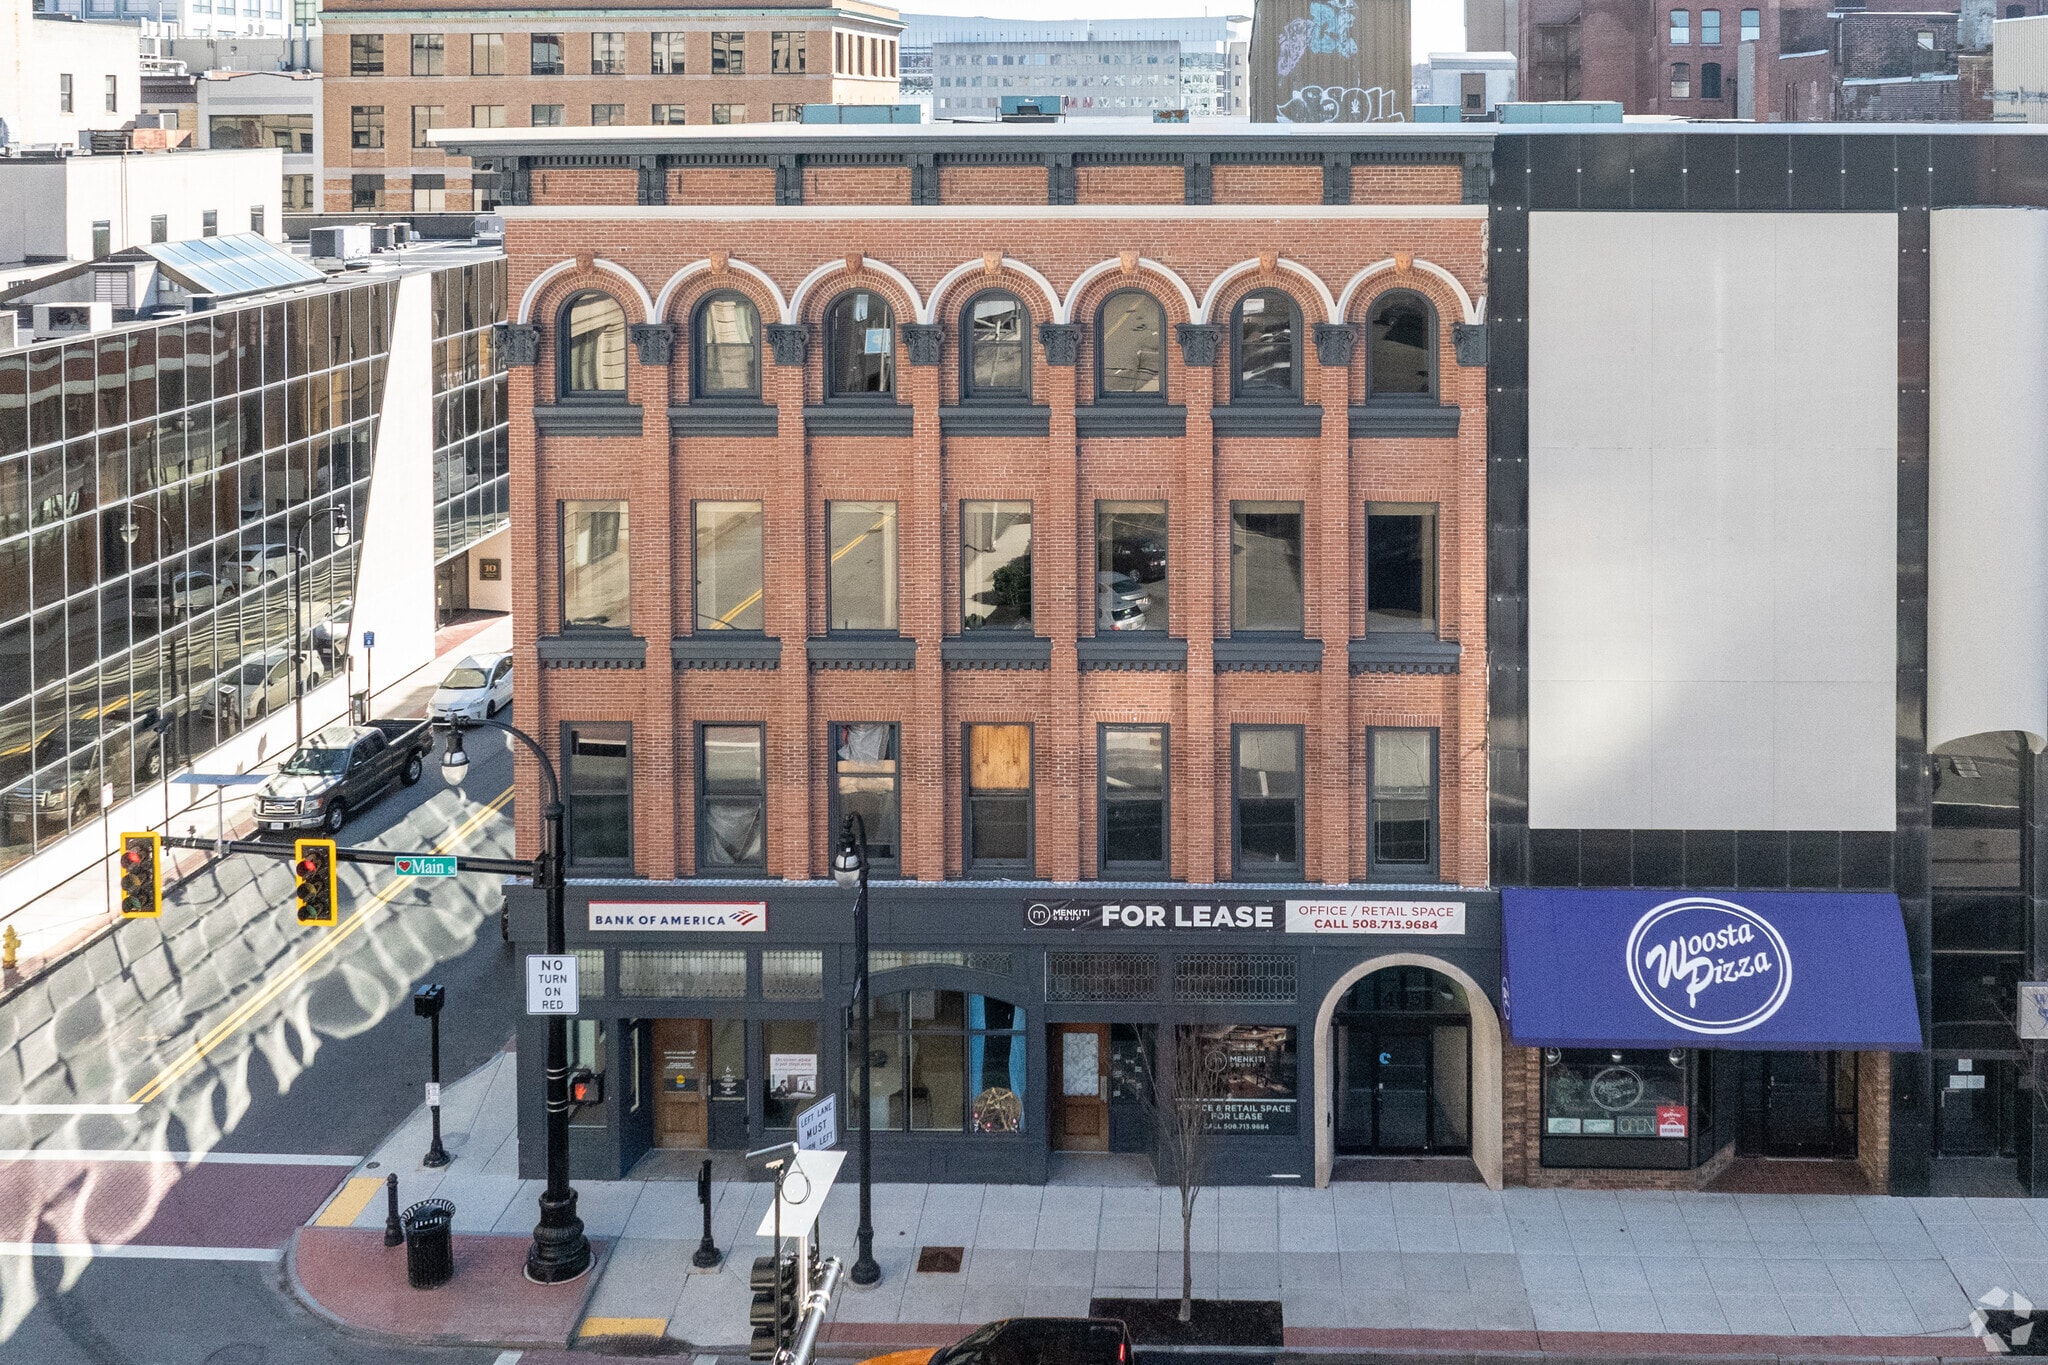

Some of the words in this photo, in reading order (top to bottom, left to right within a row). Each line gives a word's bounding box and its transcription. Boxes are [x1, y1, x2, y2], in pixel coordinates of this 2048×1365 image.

[412, 859, 444, 873] Main
[1053, 909, 1090, 917] MENKITI
[1102, 905, 1166, 927] FOR
[1175, 906, 1273, 928] LEASE
[1298, 906, 1347, 916] OFFICE
[1361, 907, 1407, 916] RETAIL
[1411, 908, 1454, 917] SPACE
[595, 915, 634, 925] BANK
[638, 915, 656, 925] OF
[660, 915, 726, 925] AMERICA
[1314, 919, 1348, 929] CALL
[1352, 920, 1438, 930] 508.713.9684
[1645, 923, 1755, 989] Woosta
[541, 960, 563, 971] NO
[538, 974, 567, 984] TURN
[1686, 952, 1773, 1009] Pizza
[544, 987, 561, 997] ON
[542, 1000, 564, 1010] RED
[1225, 1104, 1258, 1112] RETAIL
[801, 1113, 813, 1128] LEFT
[817, 1102, 833, 1118] LANE
[806, 1119, 827, 1140] MUST
[1620, 1119, 1655, 1133] OPEN
[820, 1131, 833, 1145] LEFT
